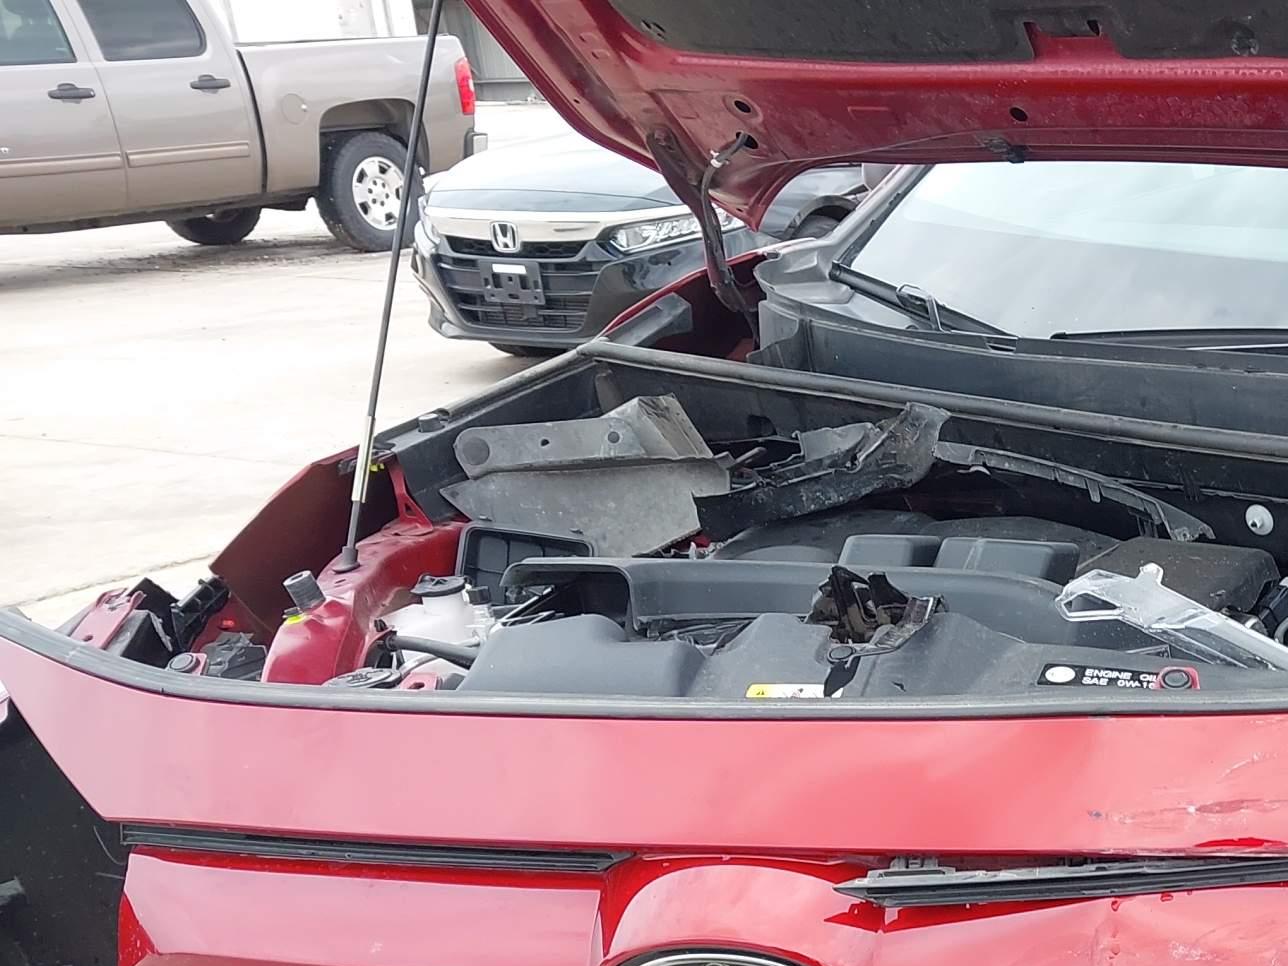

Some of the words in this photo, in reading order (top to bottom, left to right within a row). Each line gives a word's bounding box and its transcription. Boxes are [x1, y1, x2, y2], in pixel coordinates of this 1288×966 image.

[1081, 676, 1109, 686] SAE
[1084, 668, 1133, 680] ENGINE
[1139, 673, 1158, 683] OIL
